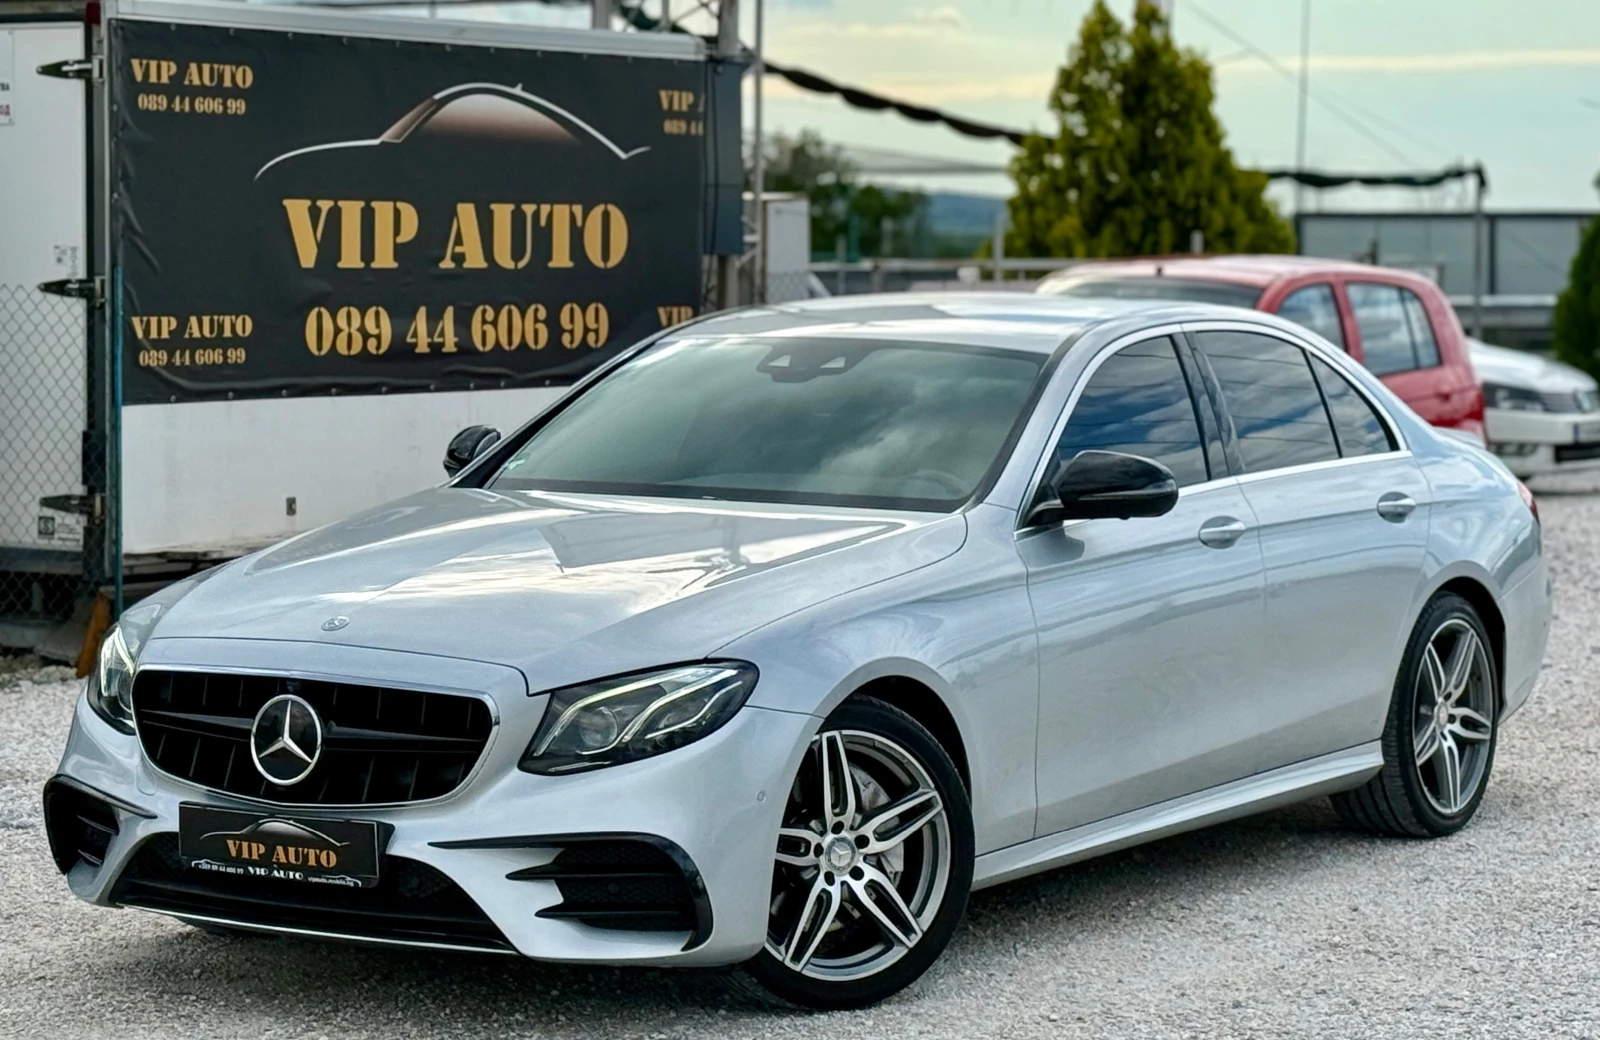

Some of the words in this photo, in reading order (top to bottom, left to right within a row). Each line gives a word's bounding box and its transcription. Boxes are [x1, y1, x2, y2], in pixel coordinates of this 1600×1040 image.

[130, 58, 178, 85] VIP
[183, 62, 254, 89] AUTO
[137, 93, 168, 111] 089
[170, 96, 191, 113] 44
[194, 97, 224, 114] 606
[226, 98, 246, 115] 99
[659, 89, 695, 112] VIP
[281, 198, 420, 269] VIP
[438, 202, 629, 270] AUTO
[131, 315, 178, 340] VIP
[183, 314, 253, 339] AUTO
[657, 306, 693, 327] VIP
[304, 305, 393, 356] 089
[406, 305, 459, 354] 44
[470, 303, 549, 353] 606
[559, 302, 610, 349] 99
[138, 349, 169, 367] 089
[171, 349, 191, 366] 44
[194, 347, 224, 365] 606
[226, 347, 247, 365] 99
[226, 839, 266, 861] VIP
[271, 845, 338, 869] AUTO
[247, 866, 269, 876] VIP
[271, 868, 304, 881] AUTO
